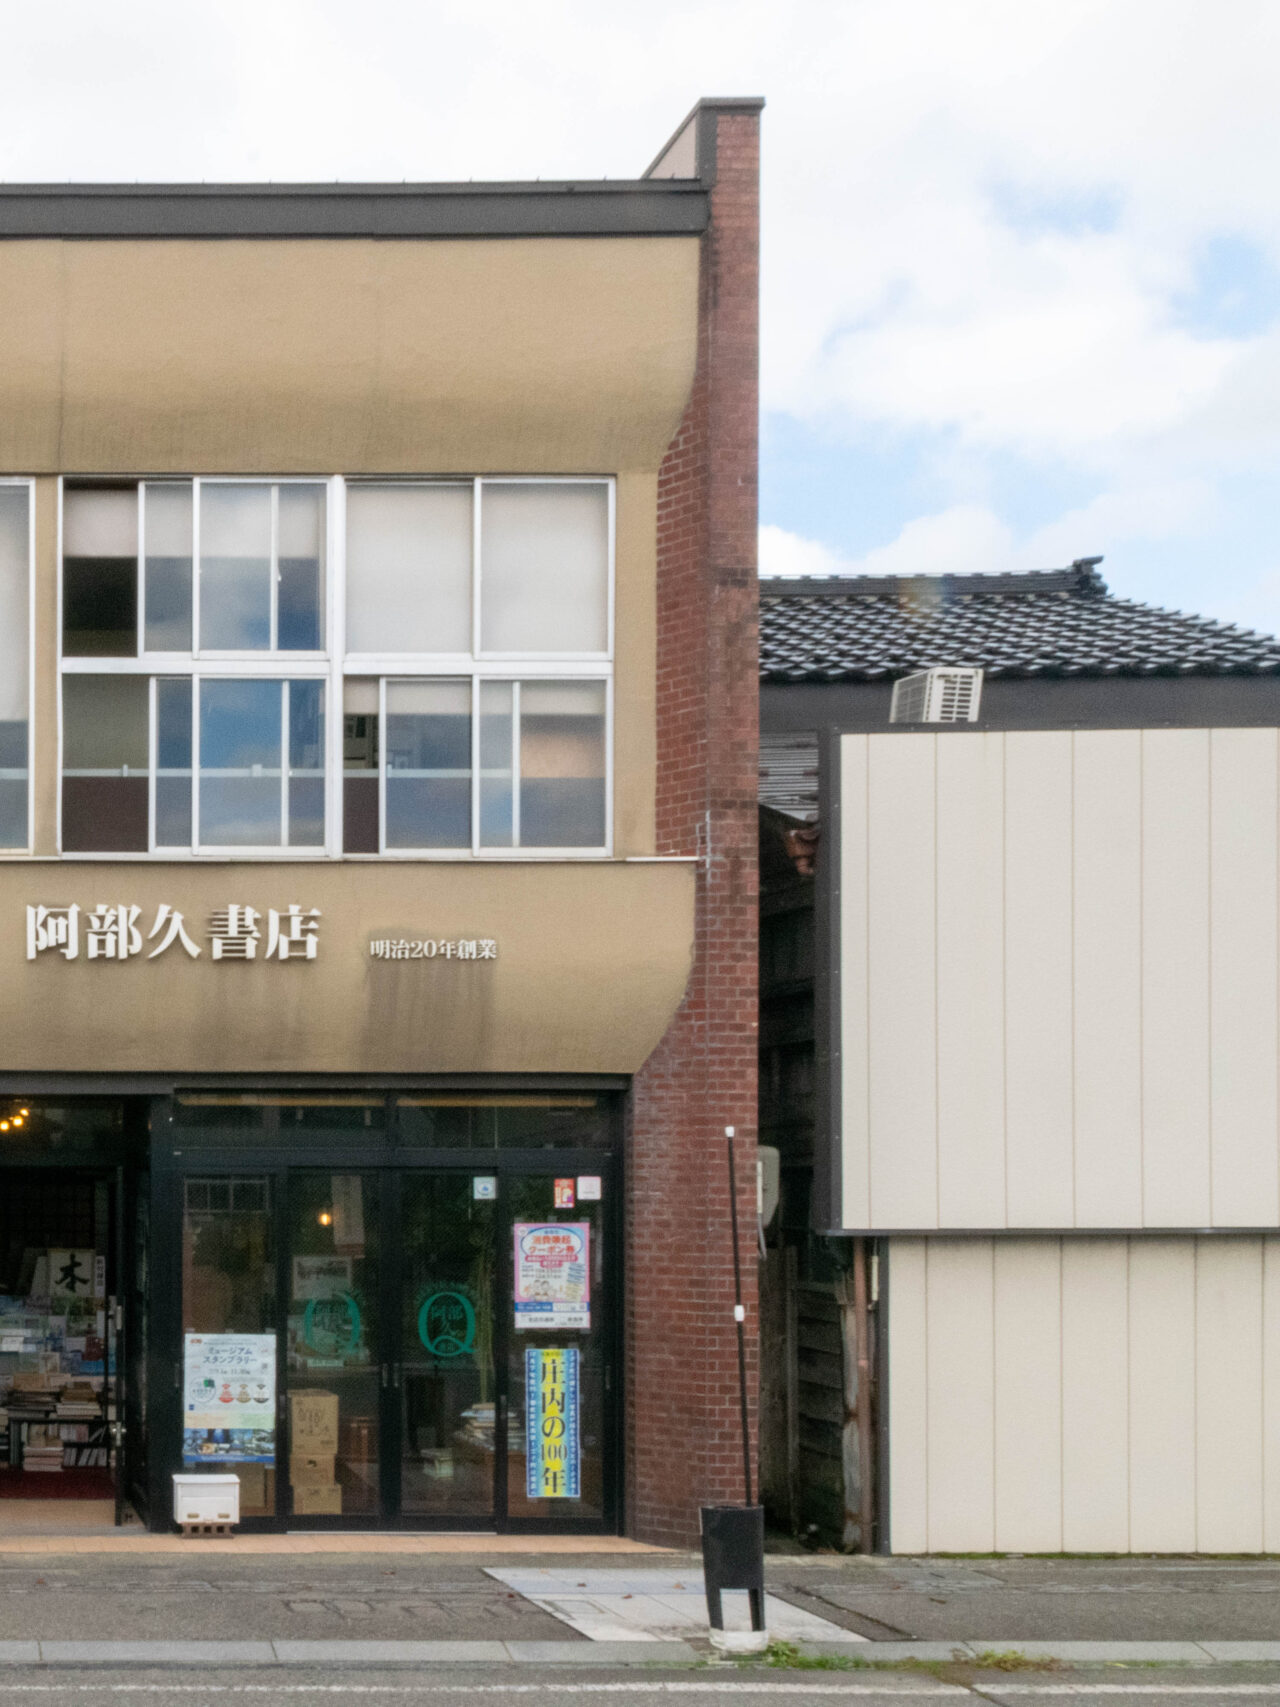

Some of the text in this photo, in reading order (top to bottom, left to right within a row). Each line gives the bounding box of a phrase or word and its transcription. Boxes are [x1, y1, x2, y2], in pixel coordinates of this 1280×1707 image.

[26, 904, 322, 960] 阿部久書店
[370, 939, 497, 960] 明治20年創業
[203, 1355, 257, 1364] スタンプラリー
[208, 1347, 253, 1355] ミュージアム
[541, 1359, 568, 1493] 庄内の100年
